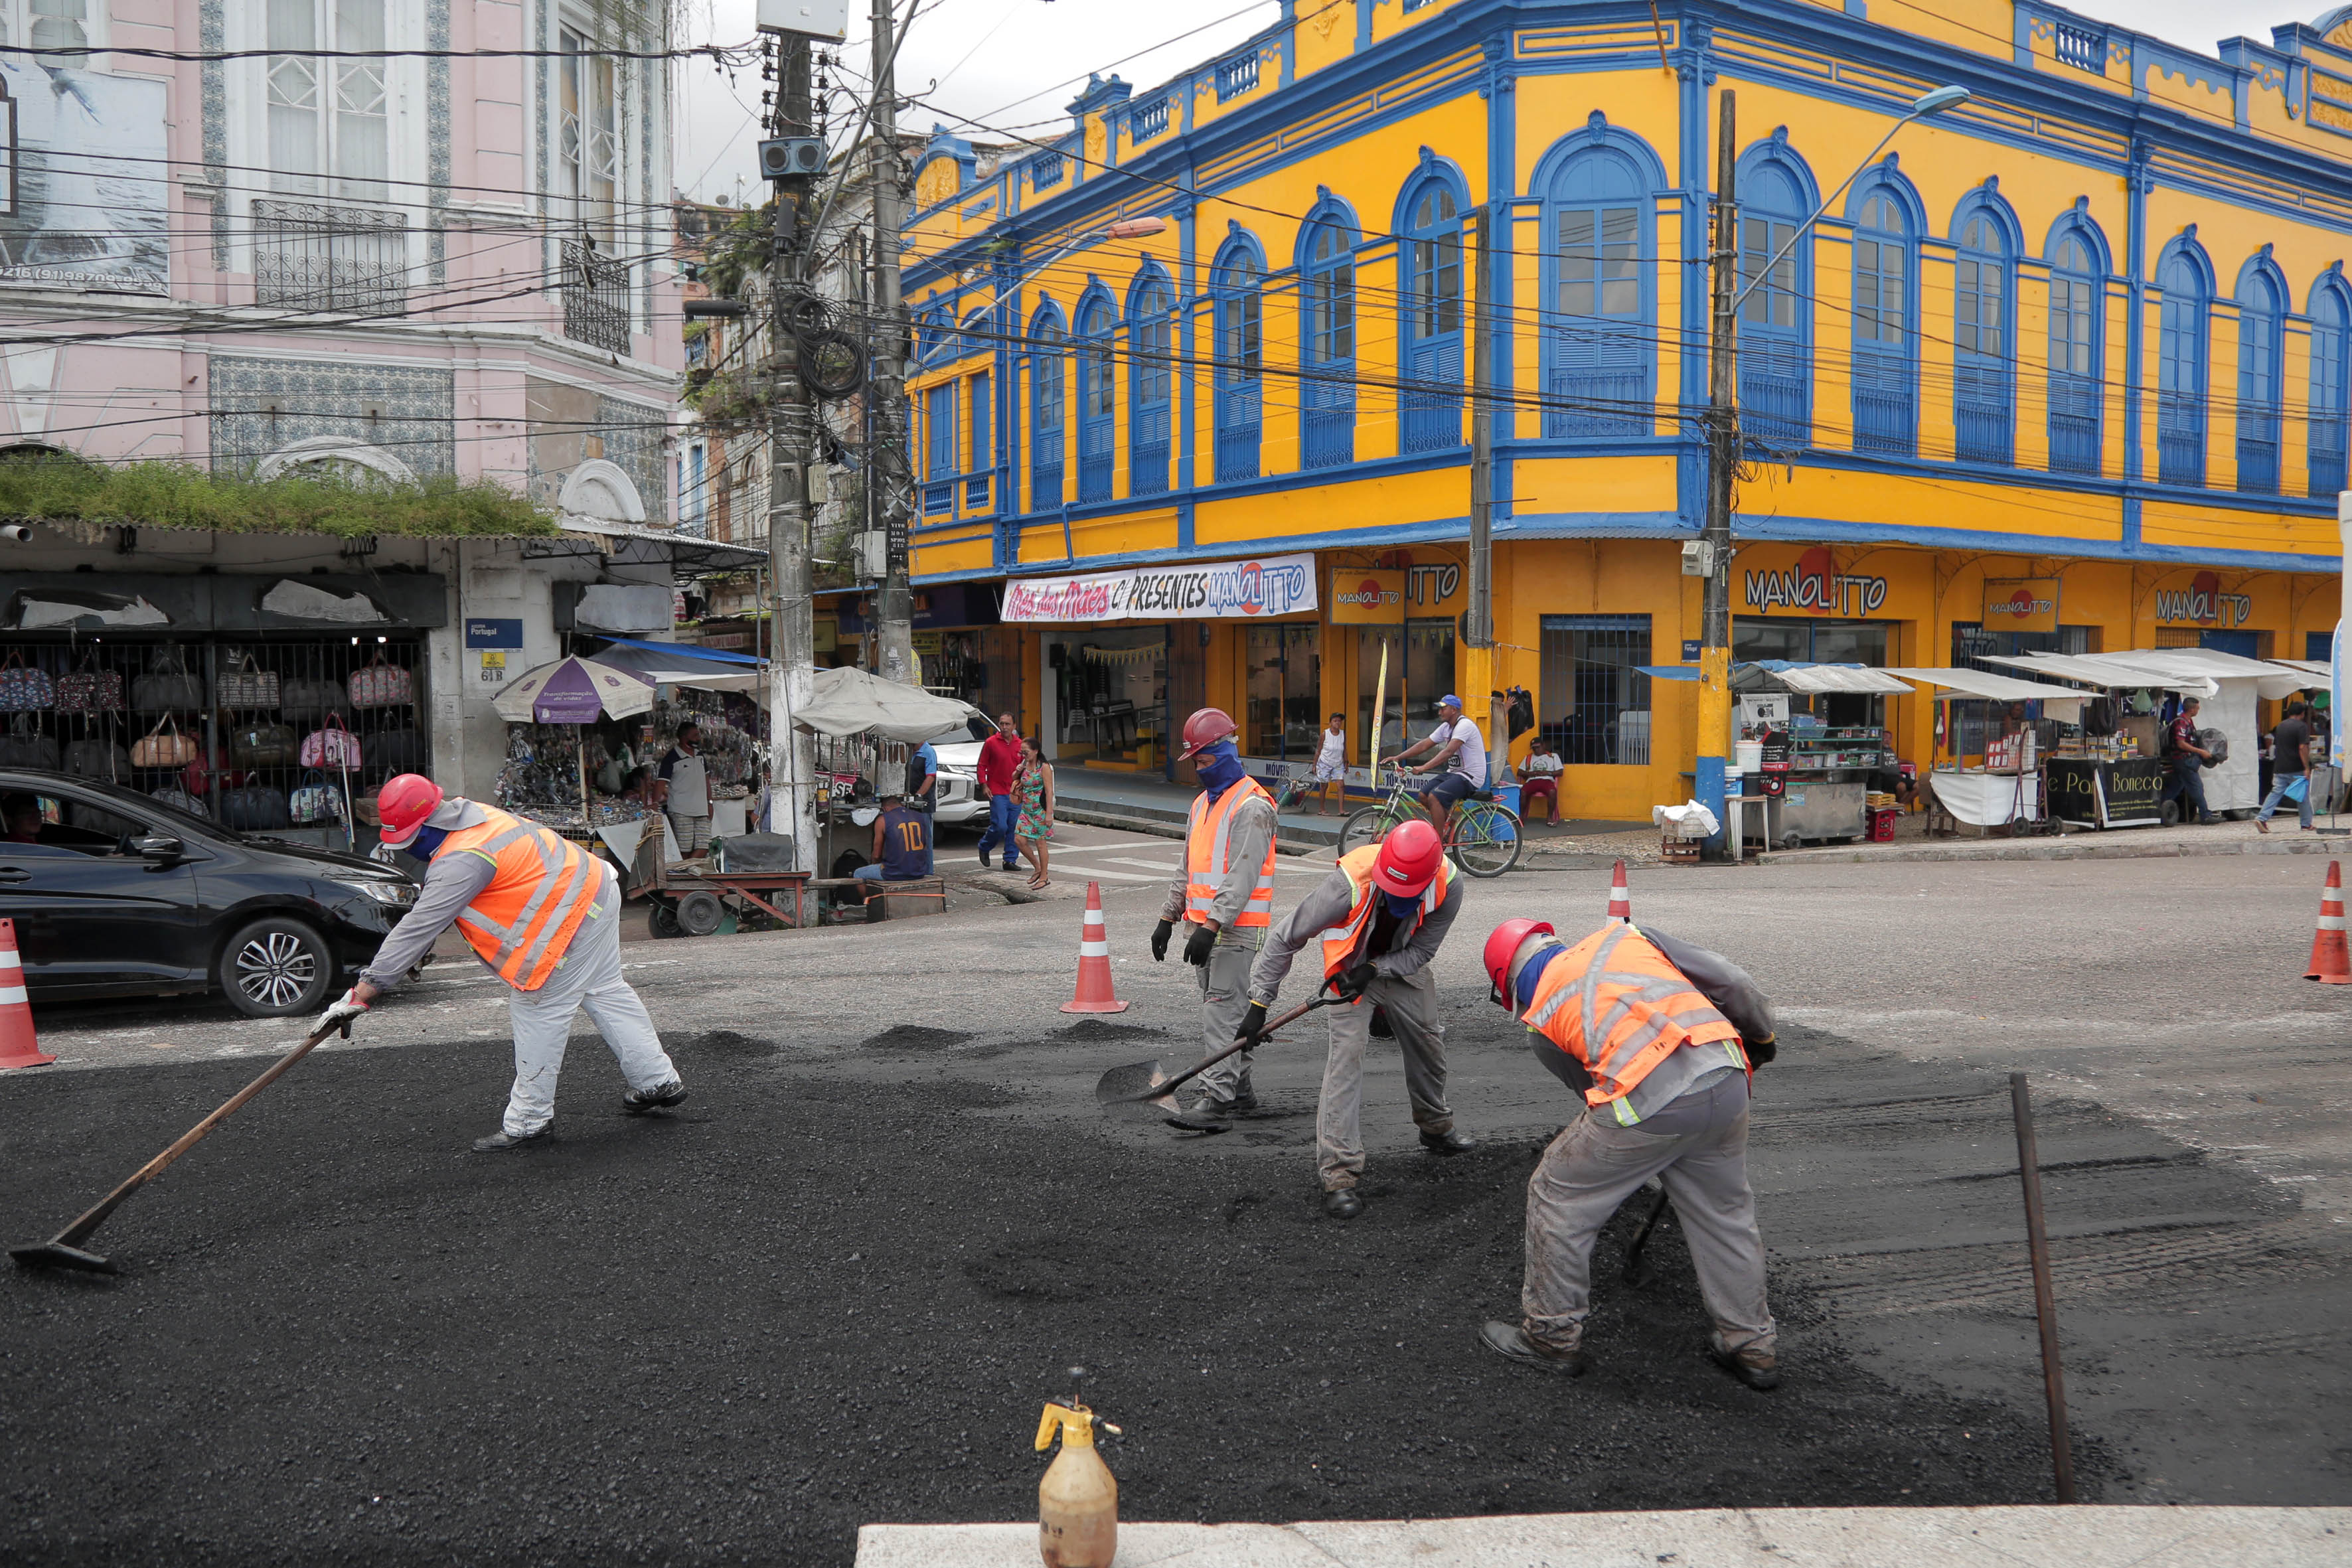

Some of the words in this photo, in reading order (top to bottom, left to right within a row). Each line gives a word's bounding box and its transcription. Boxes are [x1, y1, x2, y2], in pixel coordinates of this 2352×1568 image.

[1006, 584, 1036, 619] Mês
[1036, 585, 1061, 617] das
[1057, 580, 1109, 619] Mães
[1125, 572, 1208, 612] PRESENTES
[1208, 563, 1306, 615] MANOLITTO
[1336, 591, 1400, 605] MANOLITTO
[1744, 563, 1887, 617] MANOLITTO
[2156, 584, 2251, 627] MANOLITTO
[1989, 600, 2053, 615] MANOLITTO
[1265, 762, 1290, 777] MÓVEIS
[898, 821, 924, 852] 10
